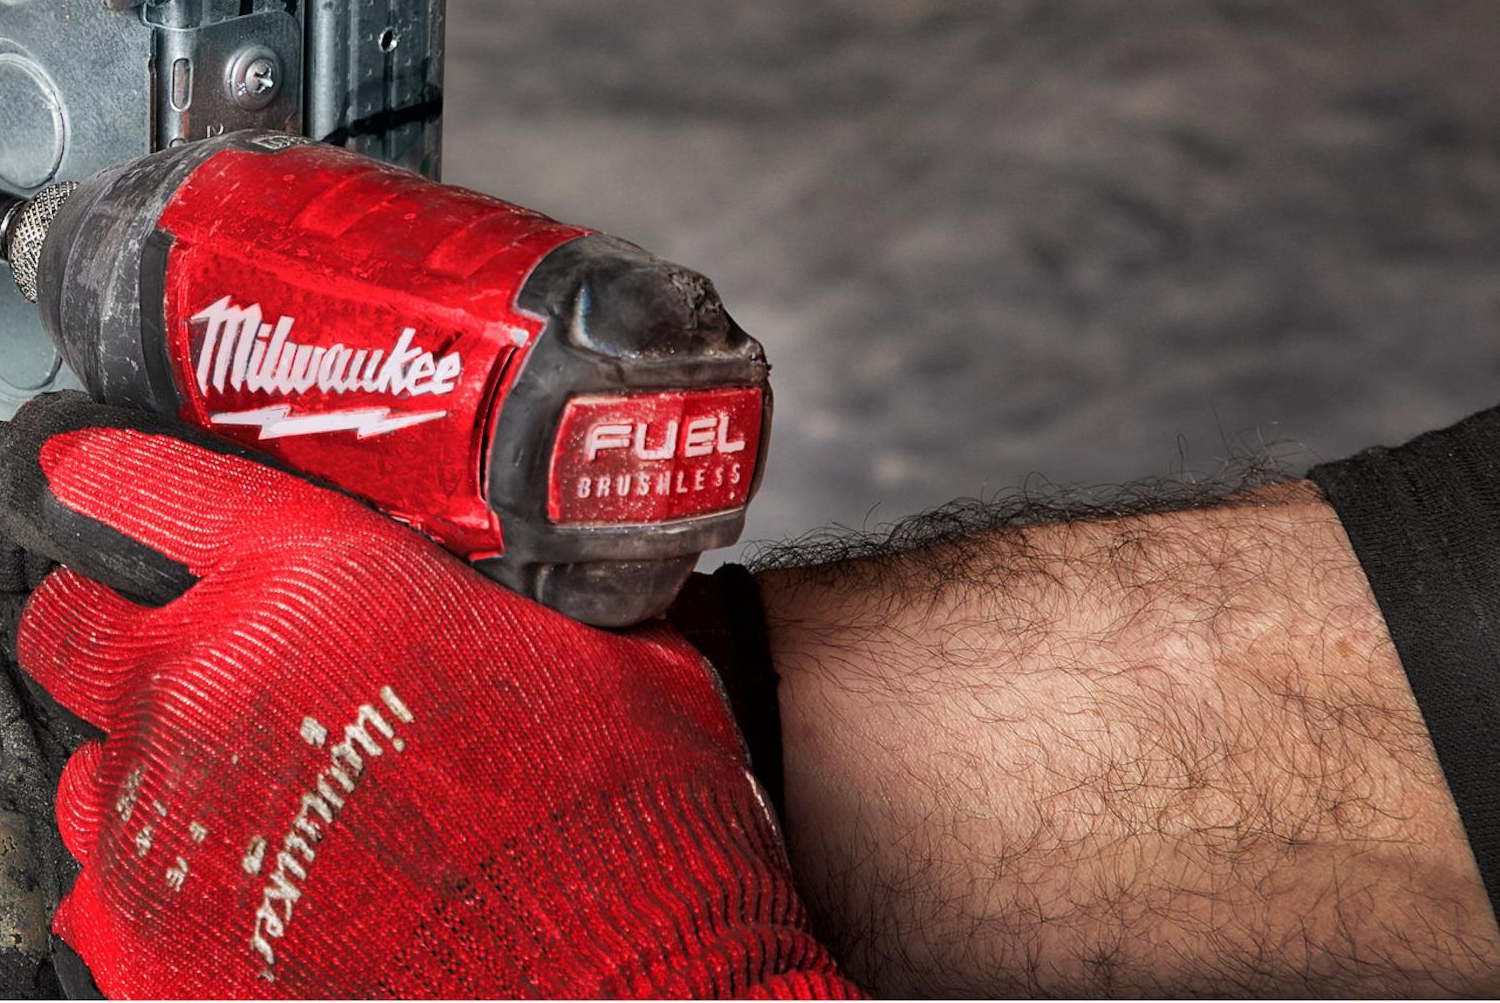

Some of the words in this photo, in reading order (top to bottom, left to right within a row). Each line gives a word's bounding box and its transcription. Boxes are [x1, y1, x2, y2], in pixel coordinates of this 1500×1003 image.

[191, 295, 461, 397] Milwaukee
[584, 414, 746, 461] FUEL
[577, 463, 741, 498] BRUSHLESS
